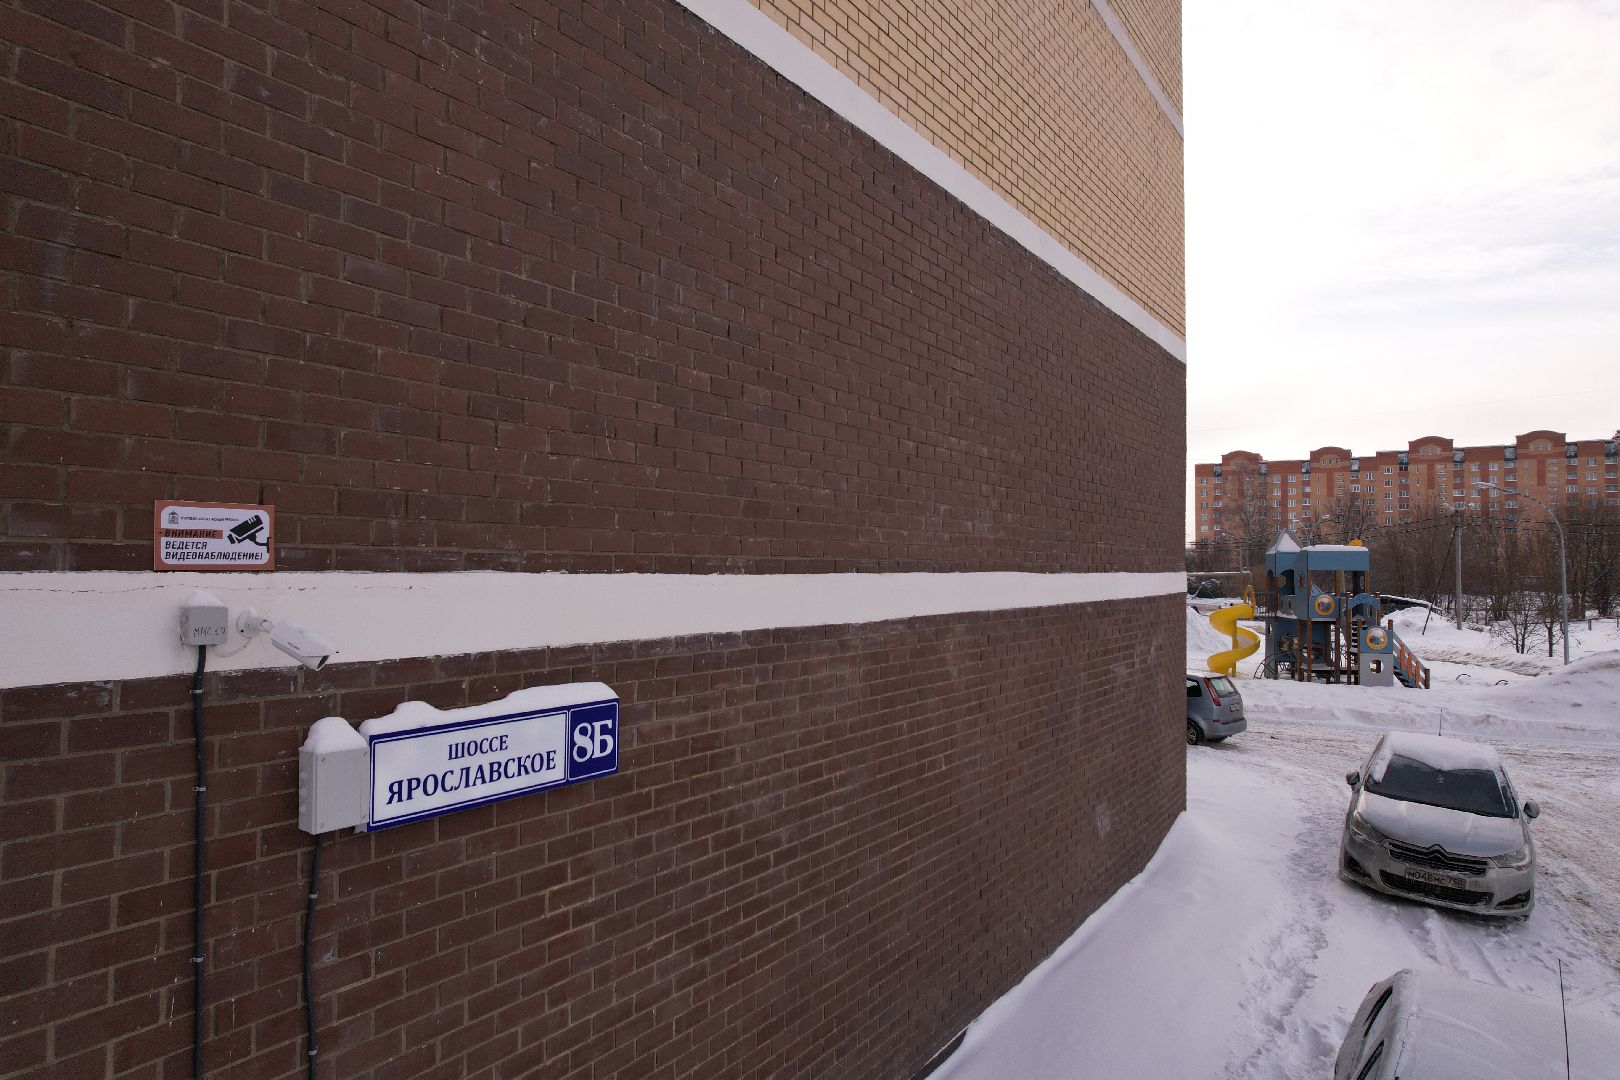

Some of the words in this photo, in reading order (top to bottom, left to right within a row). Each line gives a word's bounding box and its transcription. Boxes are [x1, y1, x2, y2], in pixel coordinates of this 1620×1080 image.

[165, 530, 217, 539] ВНИМАНИЕ
[165, 541, 207, 550] ВЕДЕТСЯ
[165, 551, 262, 561] ВИДЕОНАБЛЮДЕНИЕ!
[448, 734, 509, 760] ШОССЕ
[572, 719, 613, 763] 8Б
[385, 750, 557, 805] ЯРОСЛАВСКОЕ
